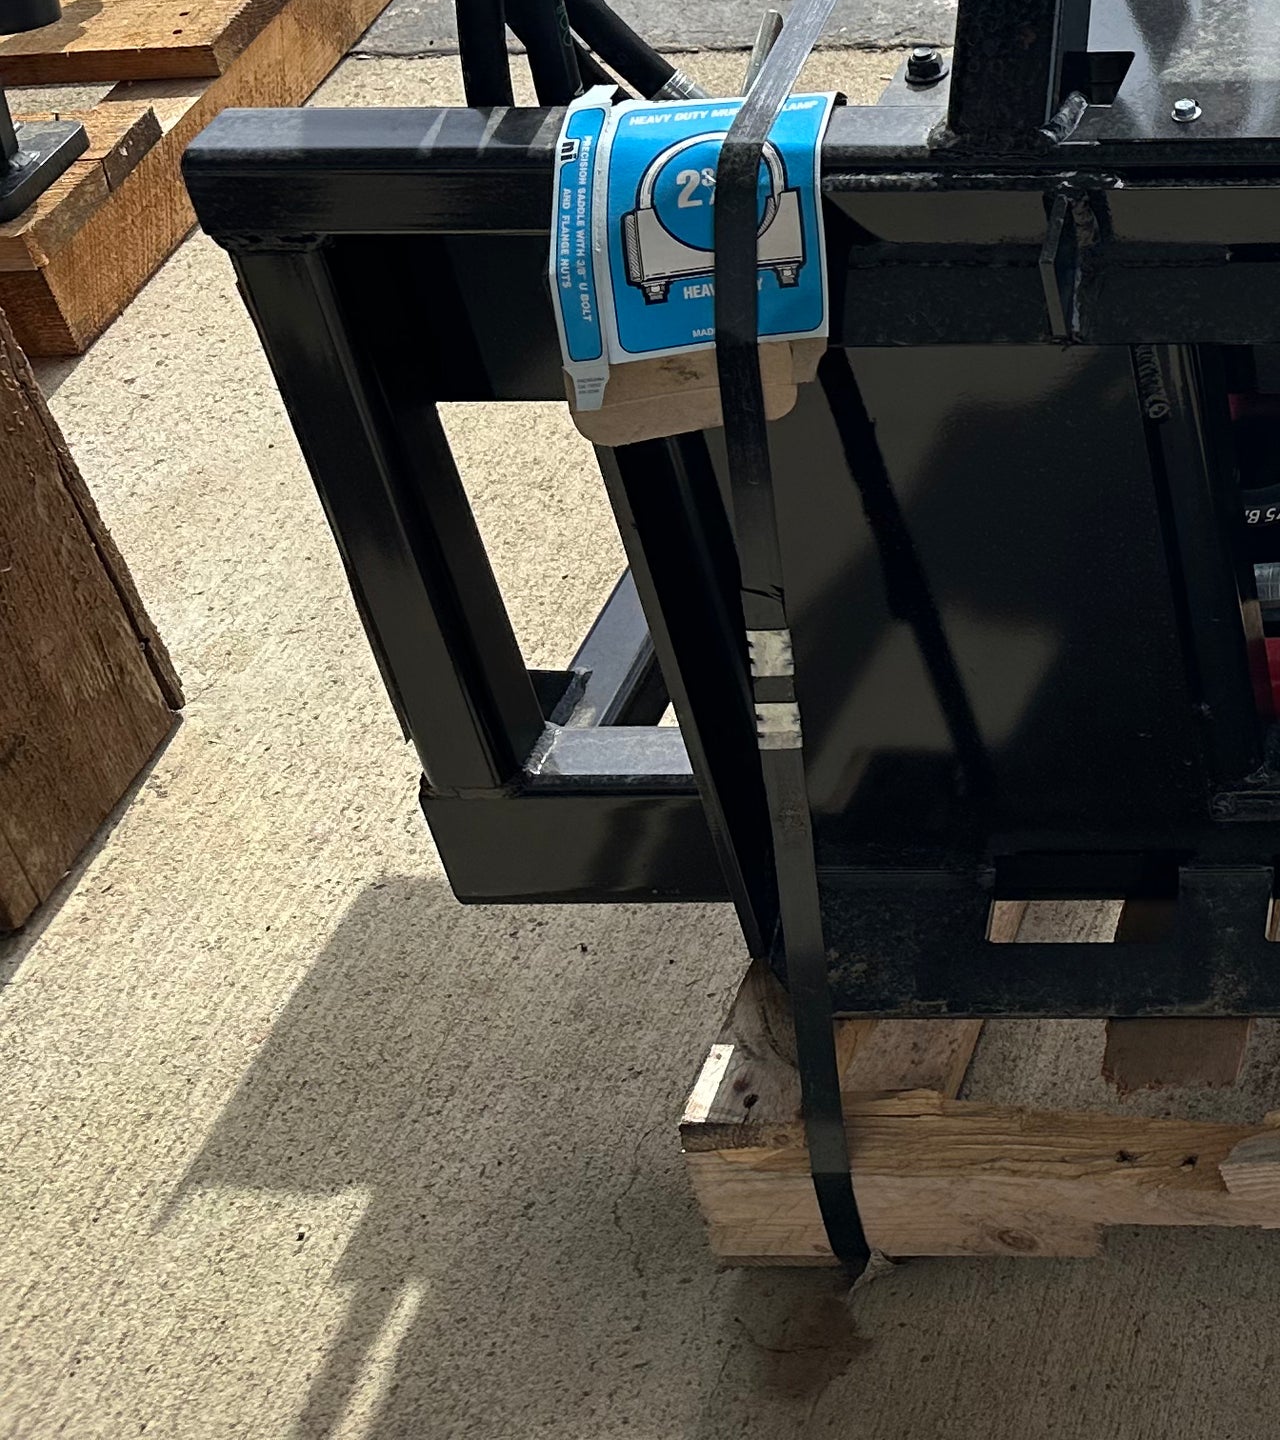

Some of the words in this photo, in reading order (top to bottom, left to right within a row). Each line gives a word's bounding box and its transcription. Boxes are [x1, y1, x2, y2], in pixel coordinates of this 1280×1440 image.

[629, 113, 671, 126] HEAVY
[674, 111, 709, 122] DUTY
[783, 99, 819, 113] LAMP
[578, 135, 593, 184] PRECISION
[562, 188, 572, 210] AND
[576, 188, 587, 226] SADDLE
[560, 215, 571, 256] FLANGE
[576, 230, 586, 257] WITH
[560, 260, 572, 289] NUTS
[578, 283, 588, 292] U
[579, 293, 593, 322] BOLT
[692, 327, 715, 338] MAD
